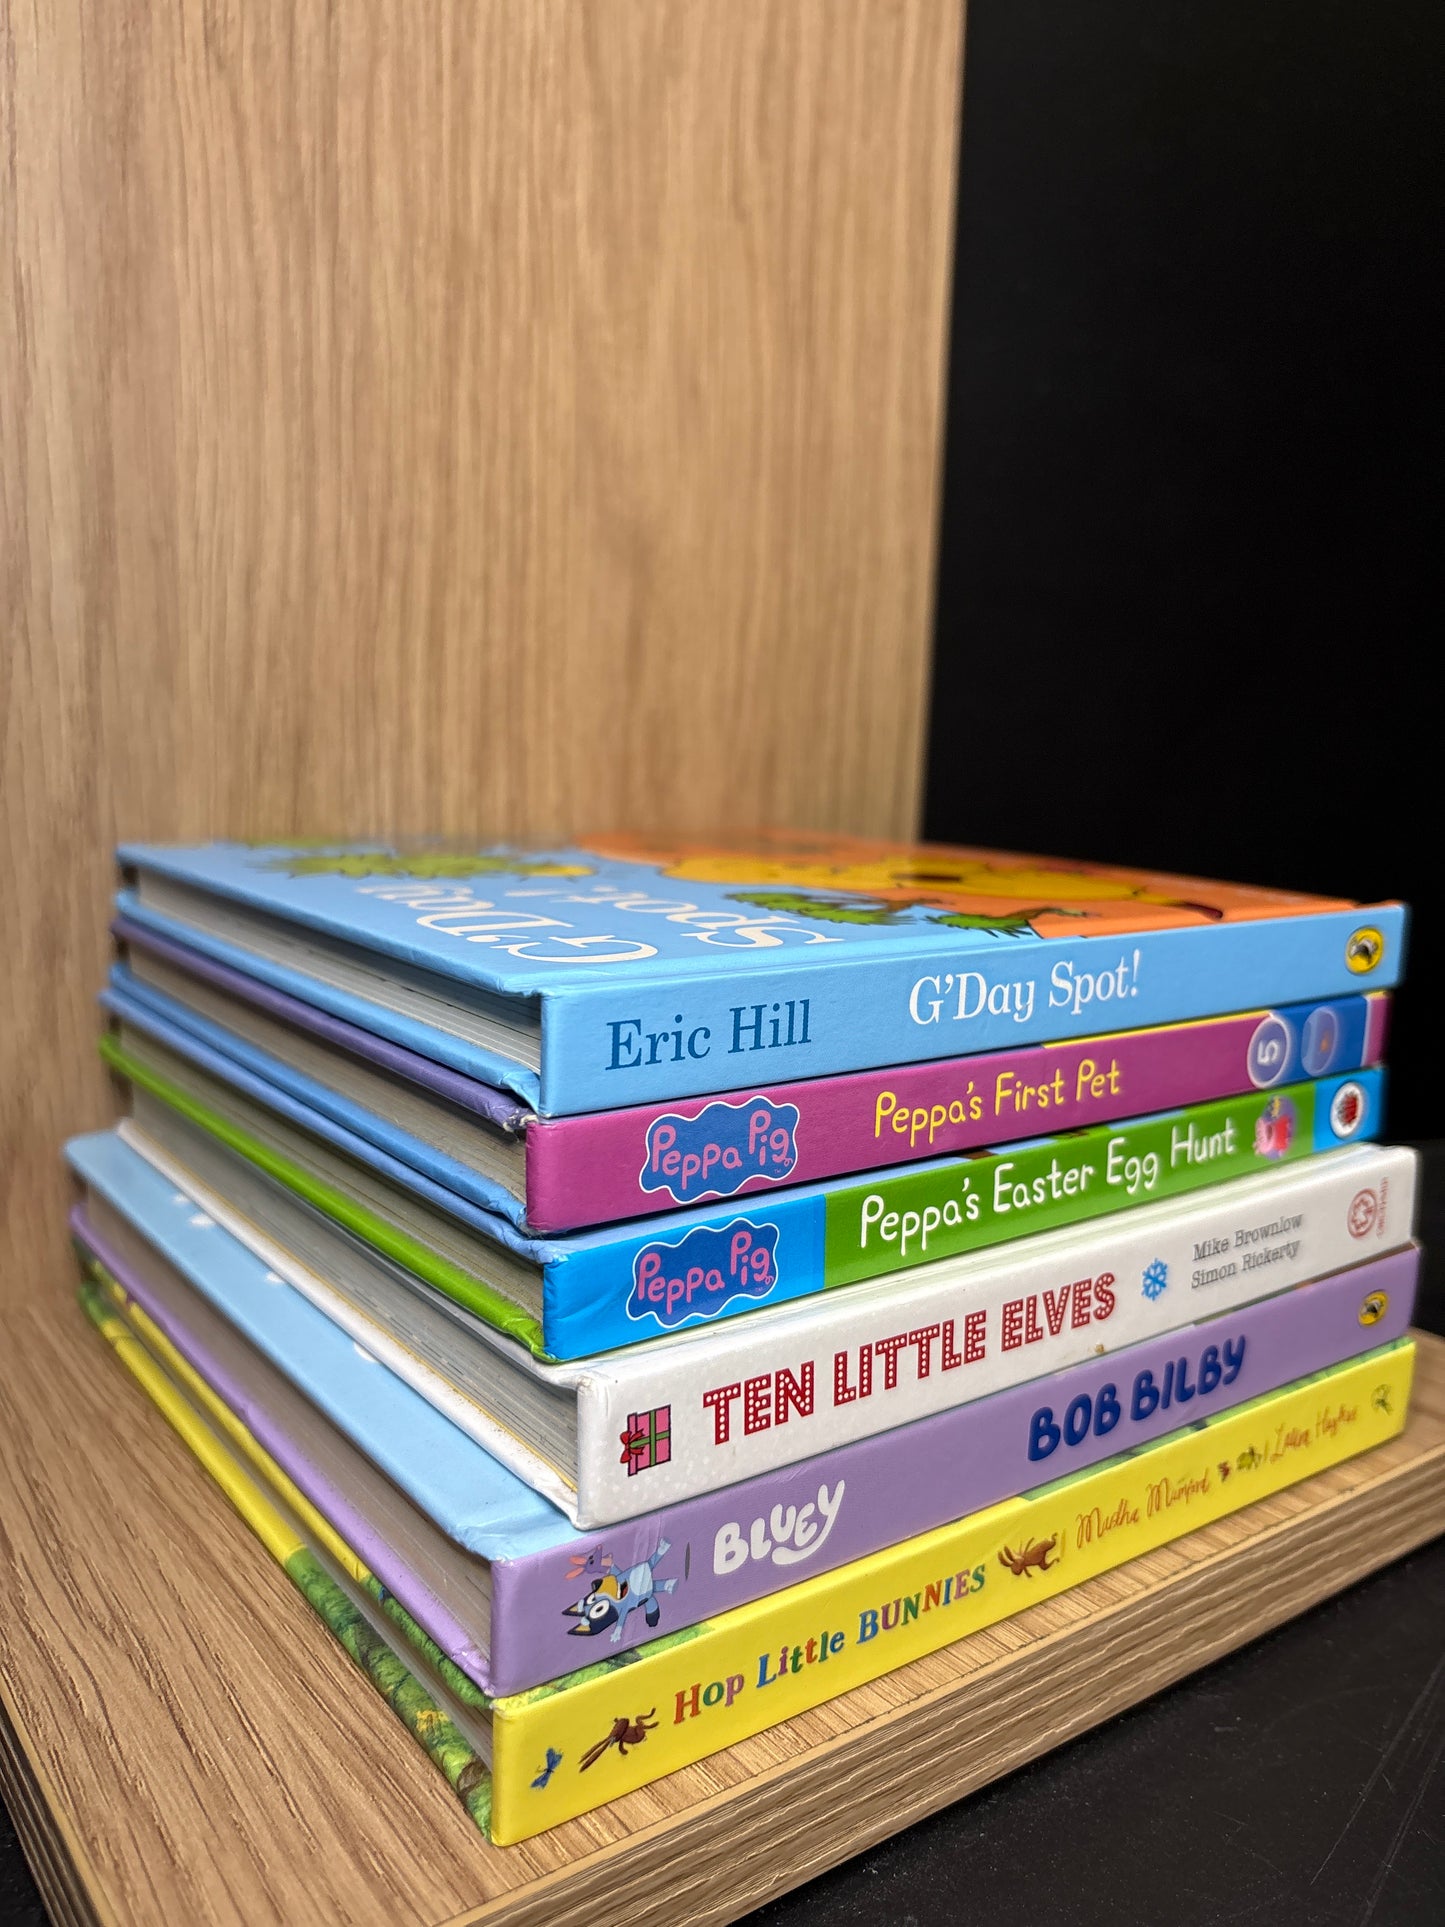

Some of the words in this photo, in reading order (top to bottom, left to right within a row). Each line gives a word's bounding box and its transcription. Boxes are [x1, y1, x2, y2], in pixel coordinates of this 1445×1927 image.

[909, 972, 1035, 1025] G'Day
[1049, 948, 1140, 1015] Spot!
[605, 1014, 711, 1070] Eric
[727, 998, 811, 1054] Hill
[1257, 1039, 1279, 1065] 5
[874, 1081, 982, 1148] Peppa's
[994, 1066, 1064, 1116] First
[1075, 1058, 1120, 1101] Pet
[652, 1124, 743, 1190] Peppa
[749, 1109, 793, 1168] Pig
[860, 1177, 979, 1256] Peppa's
[992, 1158, 1095, 1213] Easter
[1105, 1136, 1159, 1195] Egg
[1170, 1116, 1236, 1168] Hunt
[637, 1252, 725, 1315] Peppa
[730, 1231, 774, 1286] Pig
[1191, 1261, 1237, 1289] Simon
[1242, 1240, 1302, 1272] Rickerty
[1192, 1236, 1229, 1262] Mike
[1234, 1213, 1304, 1248] Brownlow
[703, 1360, 815, 1446] TEN
[833, 1309, 987, 1407] LITTLE
[1000, 1271, 1117, 1353] ELVES
[1027, 1382, 1121, 1461] BOB
[1130, 1334, 1246, 1421] BILBY
[713, 1479, 846, 1575] BLUEY
[673, 1673, 744, 1725] Hop
[755, 1630, 846, 1688] Little
[856, 1563, 986, 1645] BUNNIES
